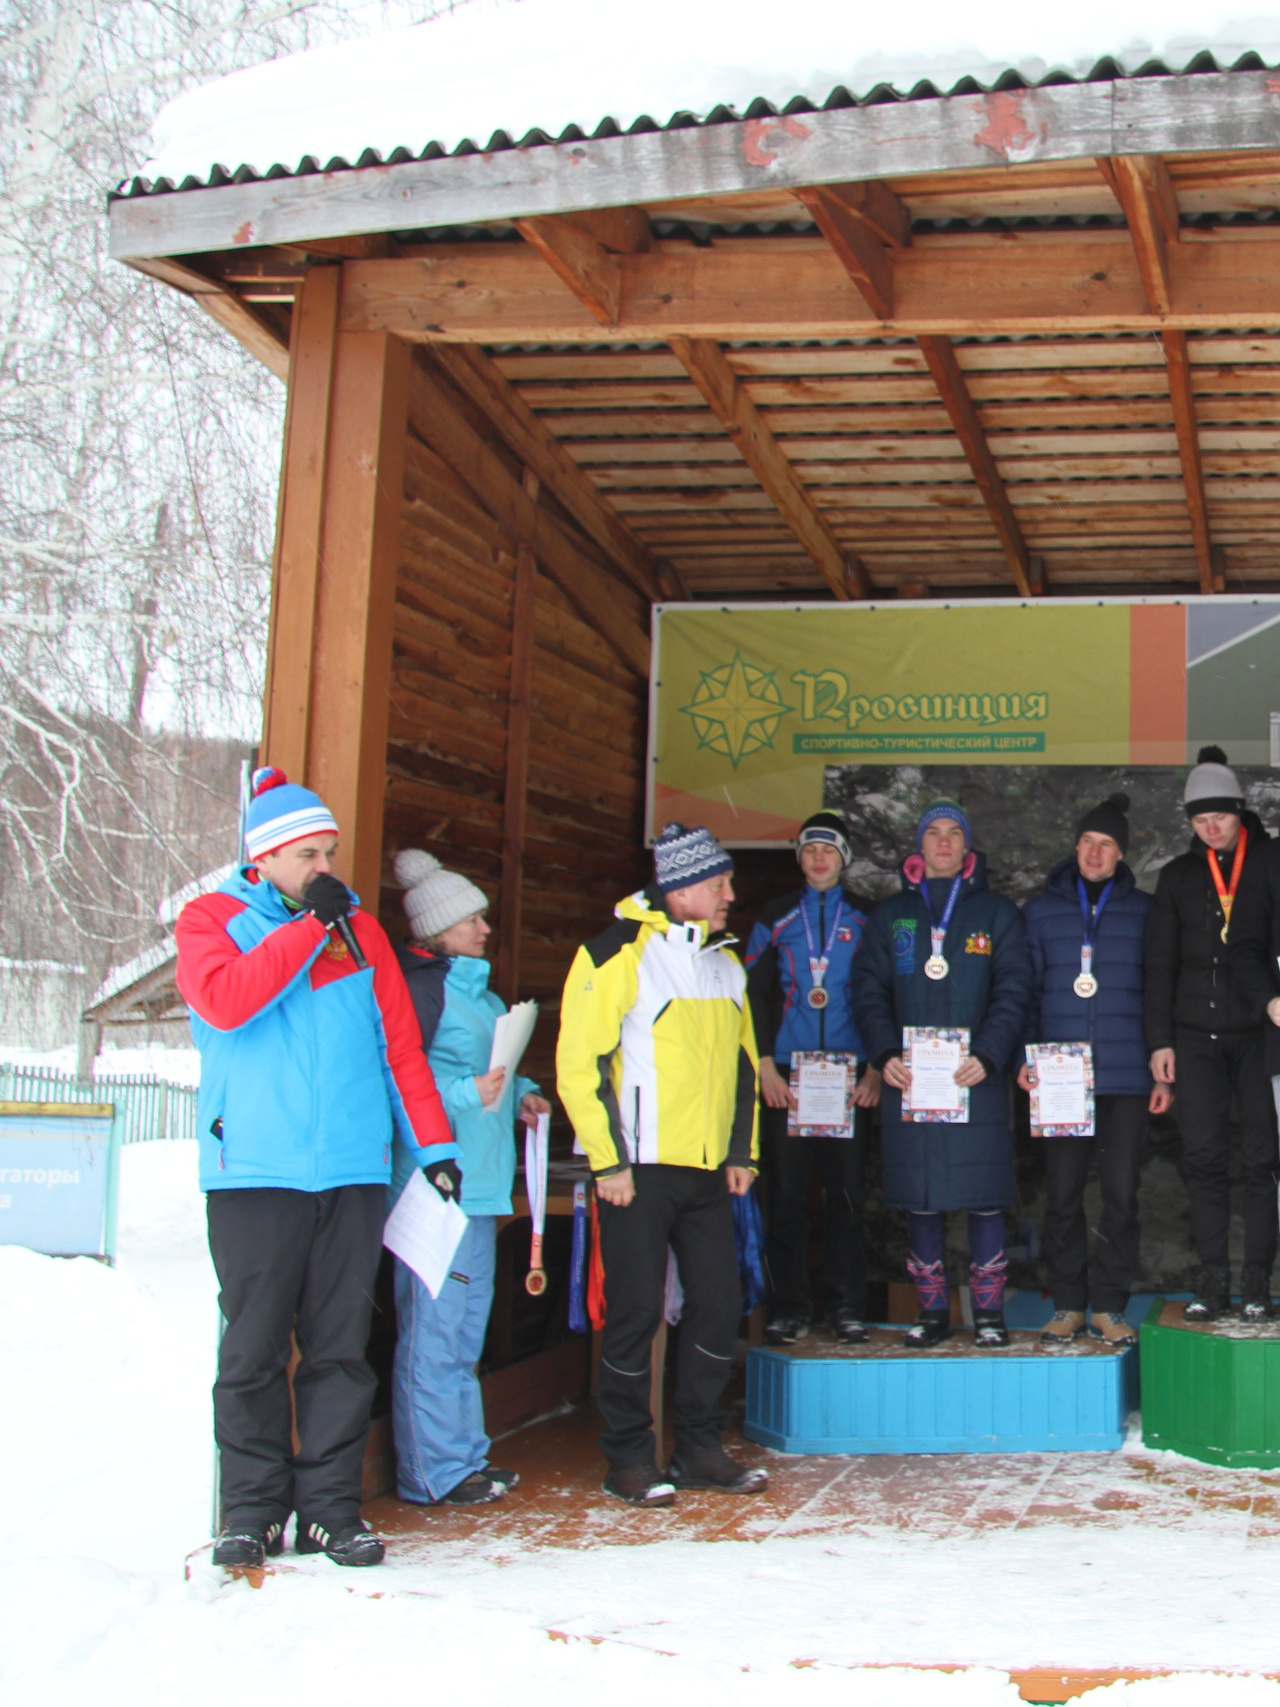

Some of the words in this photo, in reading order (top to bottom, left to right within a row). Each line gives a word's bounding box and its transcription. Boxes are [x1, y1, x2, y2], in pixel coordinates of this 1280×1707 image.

[790, 668, 1049, 731] Провинция
[800, 735, 991, 750] СПОРТИВНО-ТУРИСТИЧЕСКИЙ
[994, 735, 1037, 750] ЦЕНТР
[0, 1168, 81, 1190] гаторы
